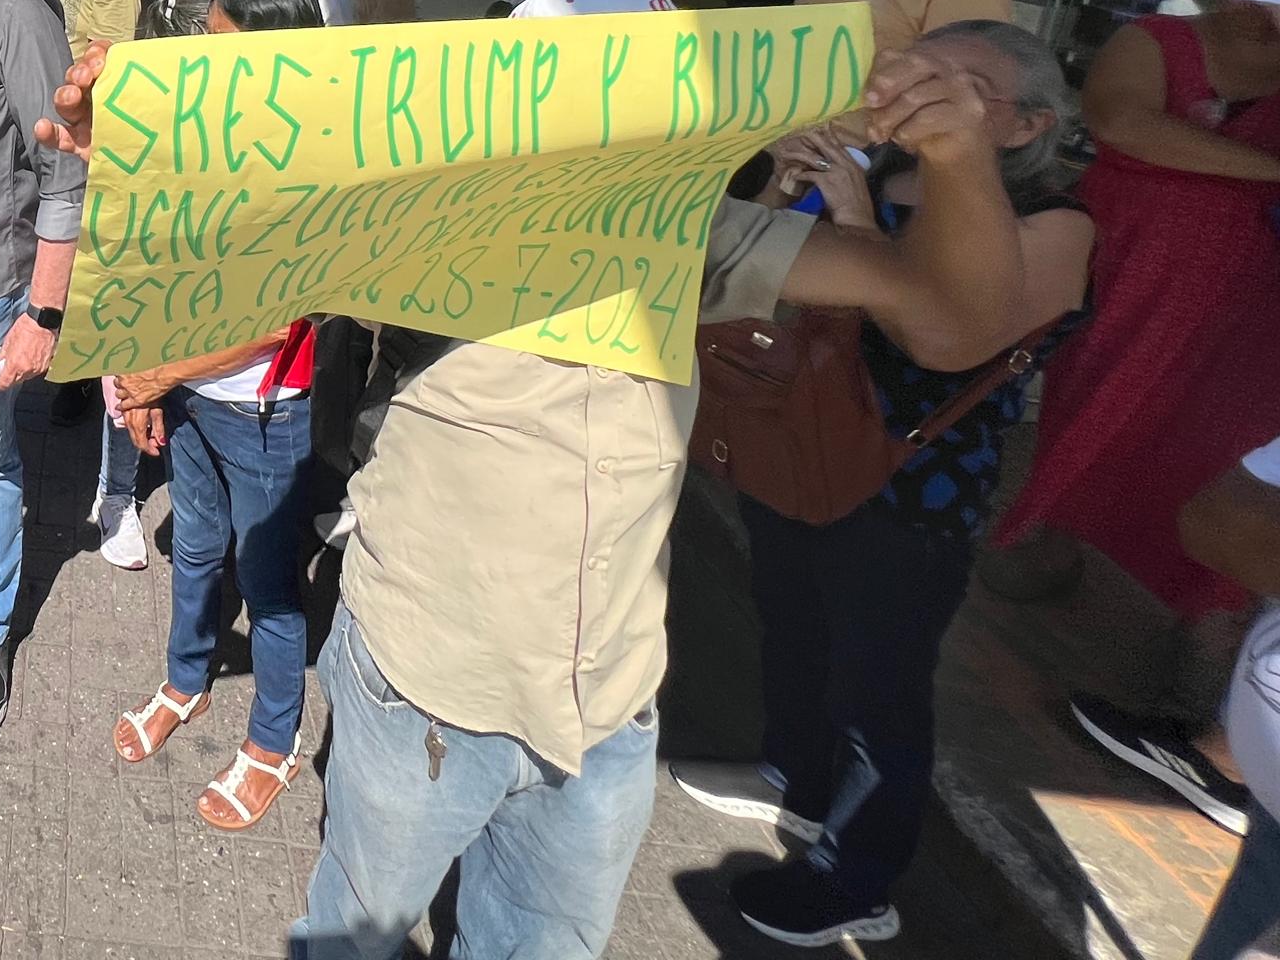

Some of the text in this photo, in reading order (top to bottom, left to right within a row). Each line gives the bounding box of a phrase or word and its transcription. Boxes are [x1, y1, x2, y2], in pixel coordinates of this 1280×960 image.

[599, 33, 632, 150] Y
[663, 24, 861, 144] RUBIO
[68, 336, 140, 375] YA
